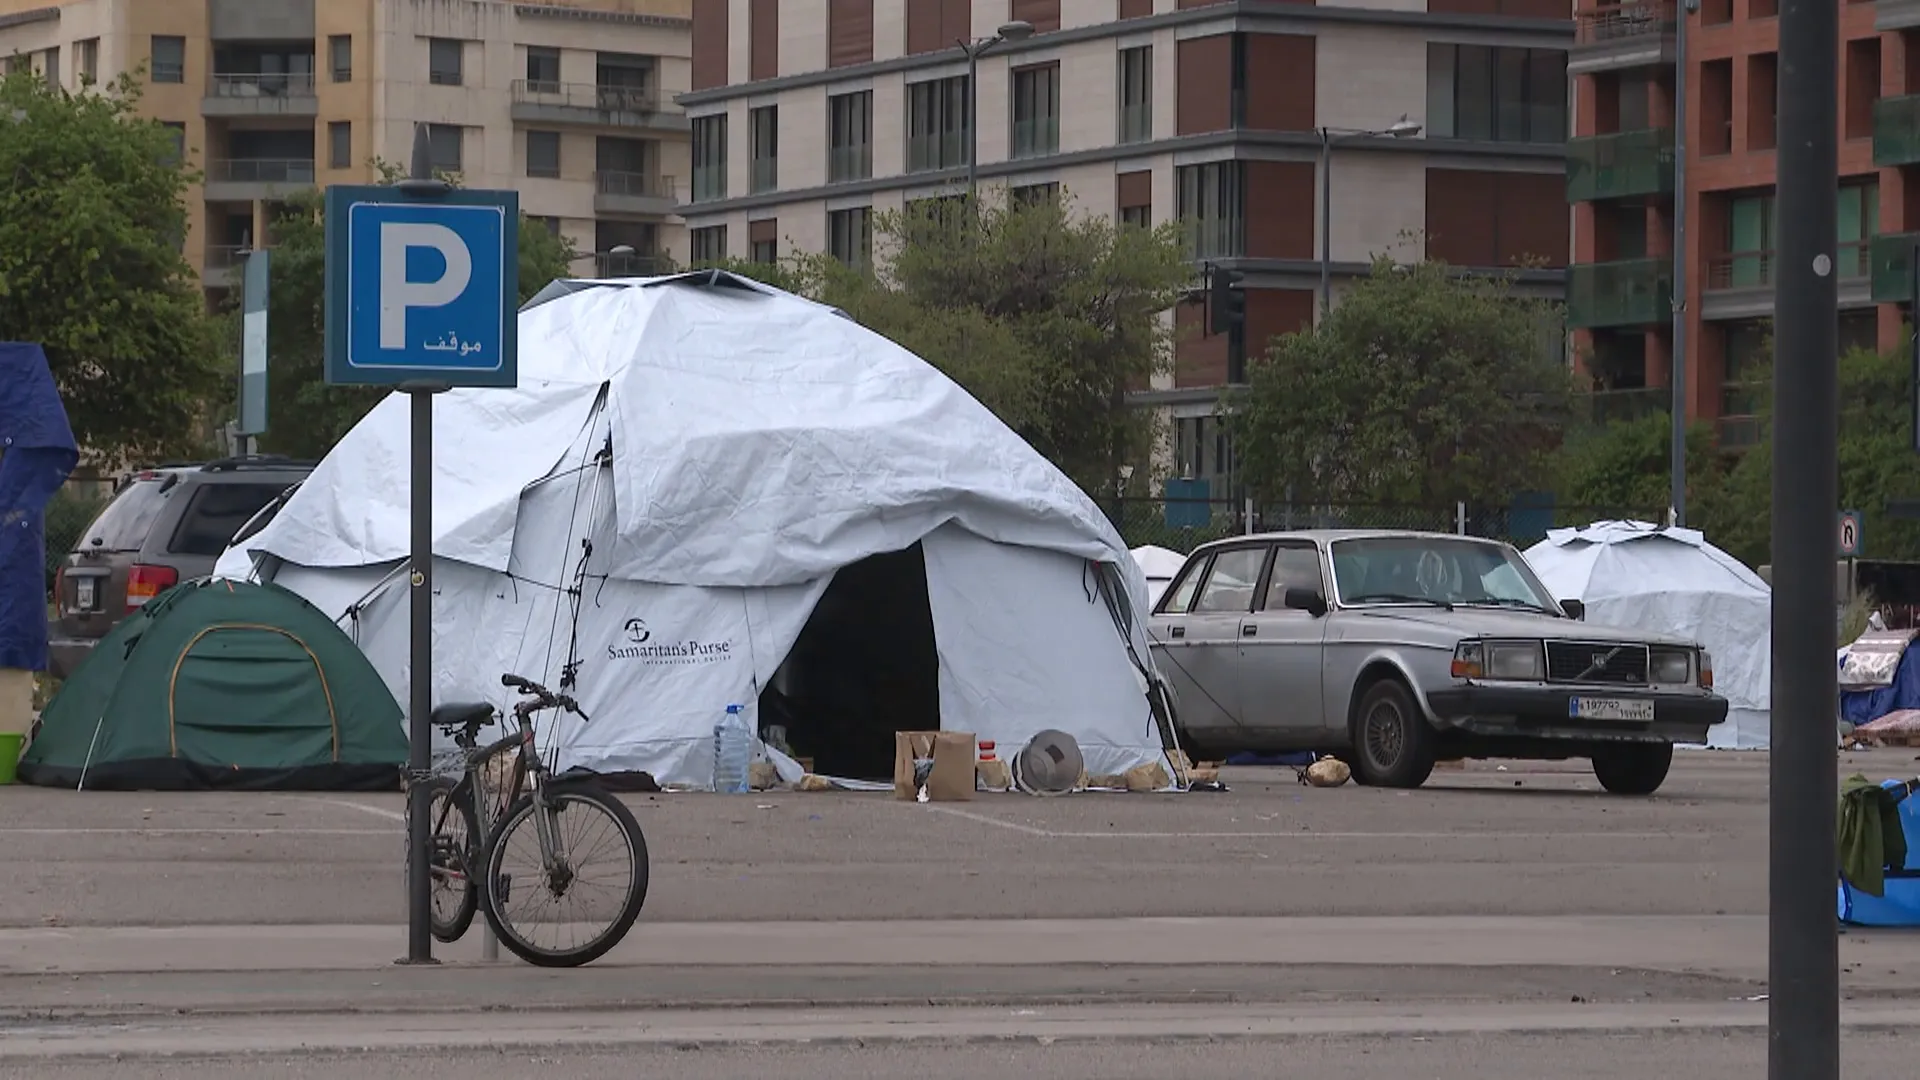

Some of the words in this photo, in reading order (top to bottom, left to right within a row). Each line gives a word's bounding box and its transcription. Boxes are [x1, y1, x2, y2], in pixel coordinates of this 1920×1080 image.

[380, 222, 472, 349] P
[423, 331, 482, 356] موقف
[608, 641, 688, 660] Samaritan's
[689, 640, 729, 656] Purse
